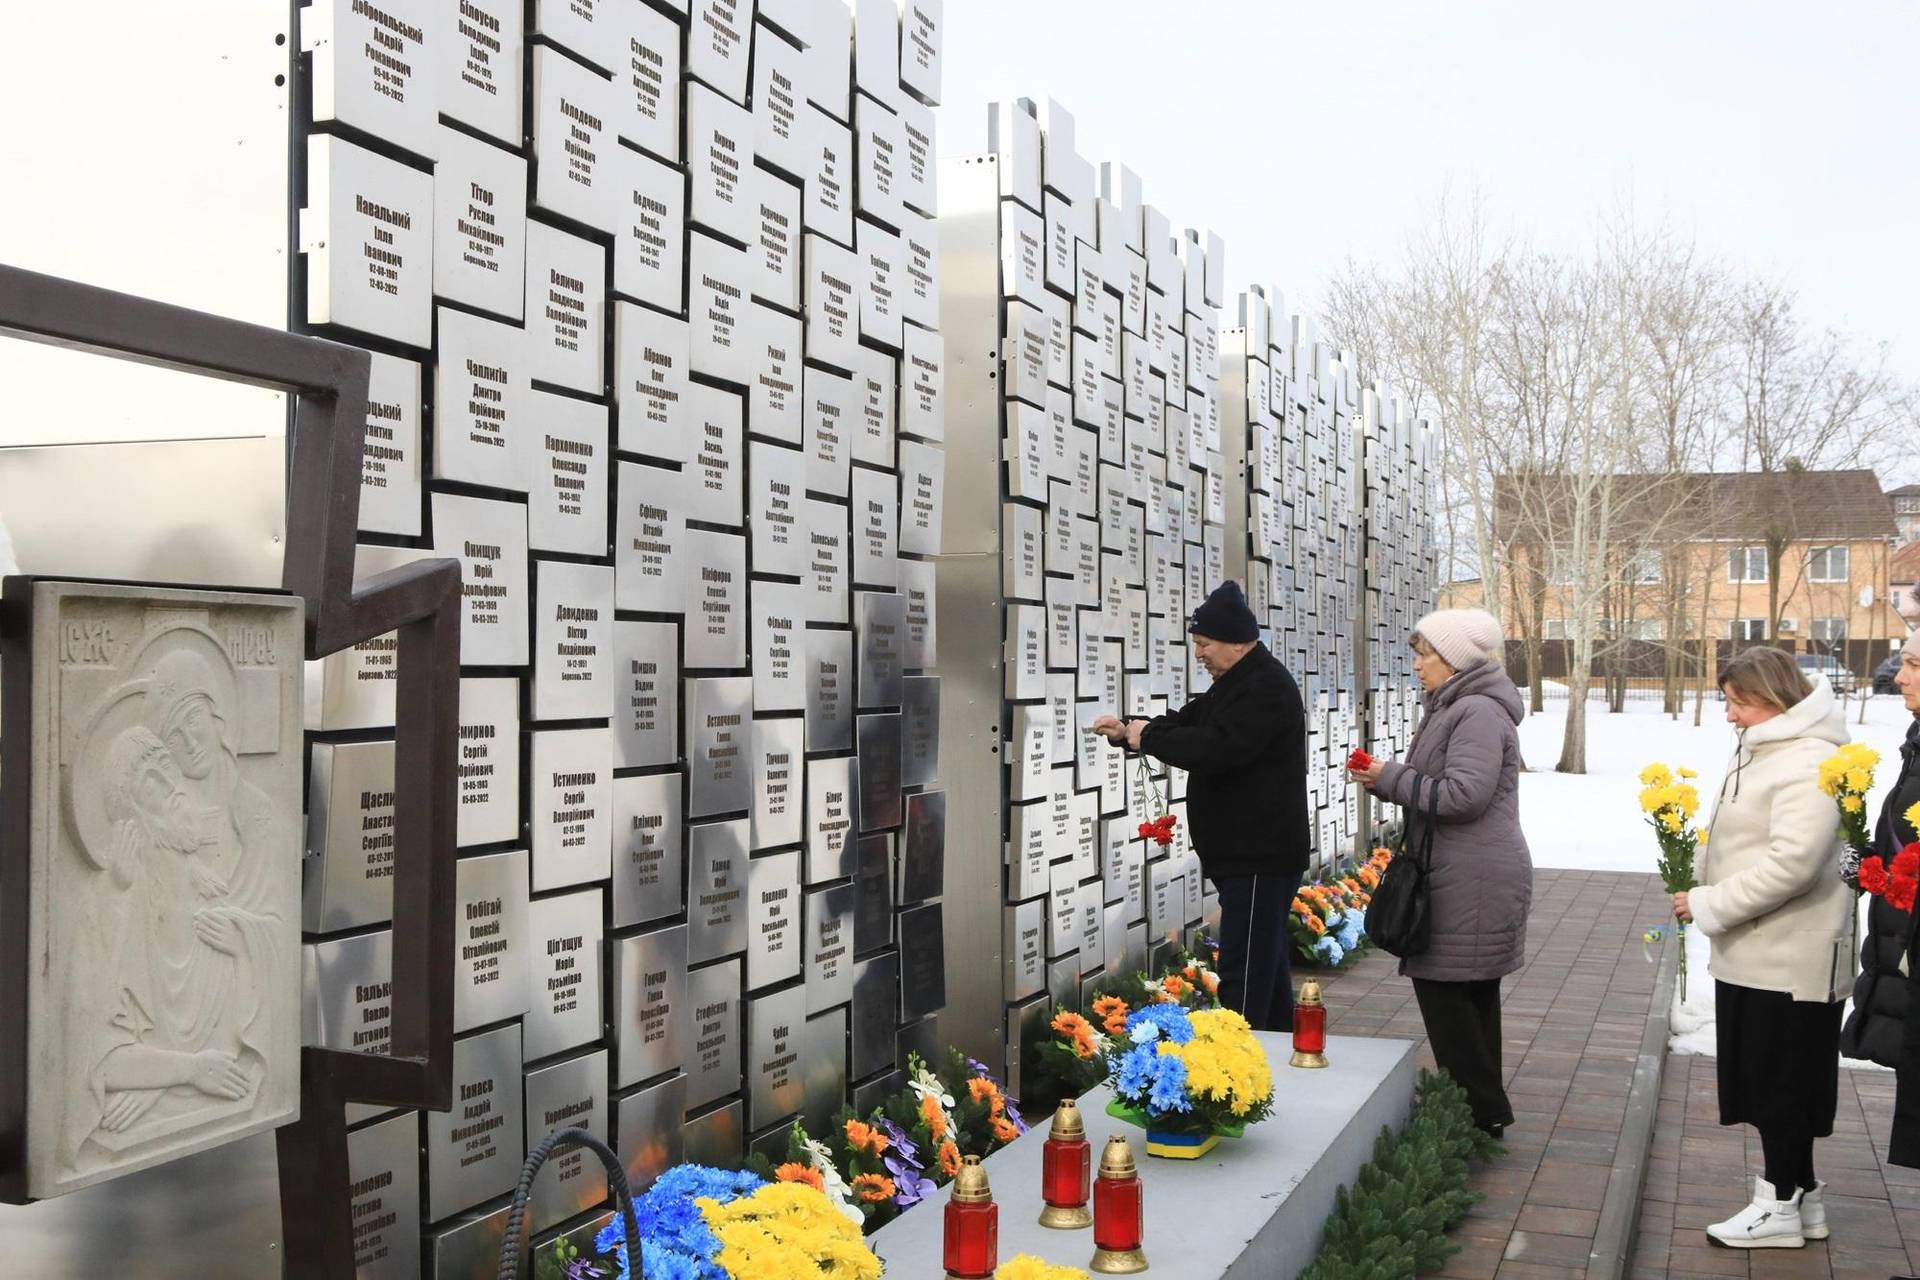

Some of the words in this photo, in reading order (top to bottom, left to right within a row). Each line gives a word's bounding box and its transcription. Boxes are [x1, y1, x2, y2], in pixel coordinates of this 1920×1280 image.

[460, 0, 500, 36] Білоусов
[373, 25, 403, 57] Андрій
[458, 18, 500, 56] Володимир
[365, 42, 411, 79] Романович
[630, 36, 663, 70] Сторчило
[485, 82, 497, 98] 2022
[560, 97, 602, 135] Холоденко
[571, 123, 591, 146] Павло
[565, 137, 596, 167] Юрійович
[471, 182, 494, 208] Тітор
[356, 194, 411, 231] Навальний
[469, 203, 495, 228] Руслан
[374, 225, 393, 246] Ілля
[458, 218, 504, 248] Михайлович
[633, 225, 666, 250] Васильович
[364, 242, 402, 269] Іванович
[487, 260, 498, 274] 2022
[550, 268, 584, 295] Величко
[549, 289, 584, 314] Владислав
[546, 304, 587, 332] Валерійович
[467, 359, 507, 385] Чаплигін
[473, 382, 501, 405] Дмитро
[366, 398, 402, 424] оцький
[469, 399, 505, 423] Юрійович
[364, 439, 404, 466] андрович
[493, 436, 505, 449] 2022
[545, 434, 593, 459] Пархоменко
[552, 456, 587, 476] Олександр
[361, 473, 387, 492] -03-2022
[554, 474, 585, 492] Павлович
[464, 540, 501, 561] Онищук
[473, 563, 493, 581] Юрій
[556, 604, 598, 623] Давиденко
[567, 626, 587, 640] Віктор
[558, 642, 596, 656] Михайлович
[582, 672, 592, 681] 2022
[463, 743, 487, 761] Сергій
[553, 769, 596, 788] Устименко
[360, 785, 395, 814] Щасли
[564, 790, 585, 807] Сергій
[362, 811, 395, 832] Анаста
[553, 807, 595, 824] Валерійович
[362, 828, 395, 853] Сергіїв
[366, 863, 394, 880] 04-03-202
[466, 896, 502, 921] Побігай
[470, 919, 500, 940] Олексій
[462, 936, 507, 961] Віталійович
[555, 955, 574, 973] Марія
[548, 970, 582, 992] Кузьмівна
[363, 1001, 390, 1025] Павло
[353, 1022, 391, 1048] Антонов
[464, 1095, 491, 1122] Андрій
[451, 1111, 504, 1144] Миколайович
